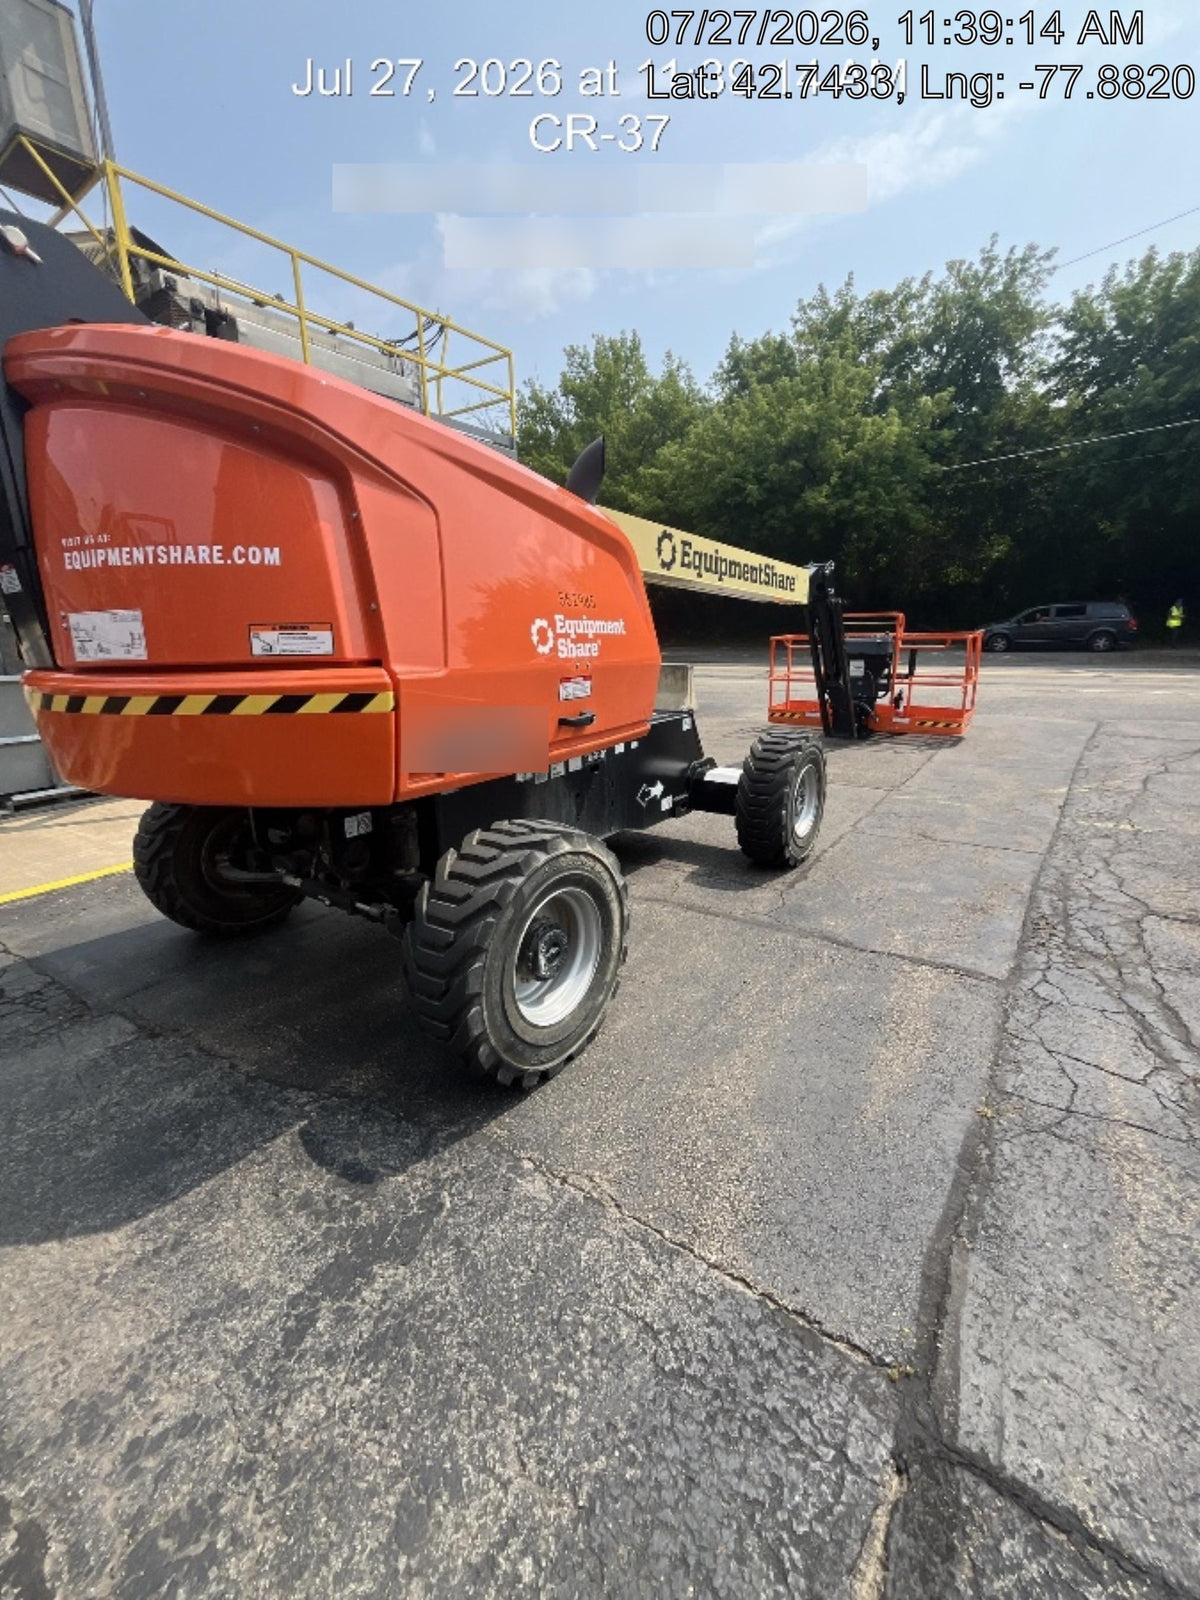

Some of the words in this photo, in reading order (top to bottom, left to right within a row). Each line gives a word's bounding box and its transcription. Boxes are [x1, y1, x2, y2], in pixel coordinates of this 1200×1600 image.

[63, 546, 281, 570] EQUIPMENTSHARE.COM
[680, 540, 796, 593] EquipmentShare
[554, 614, 627, 639] Equipment
[557, 638, 600, 659] Share
